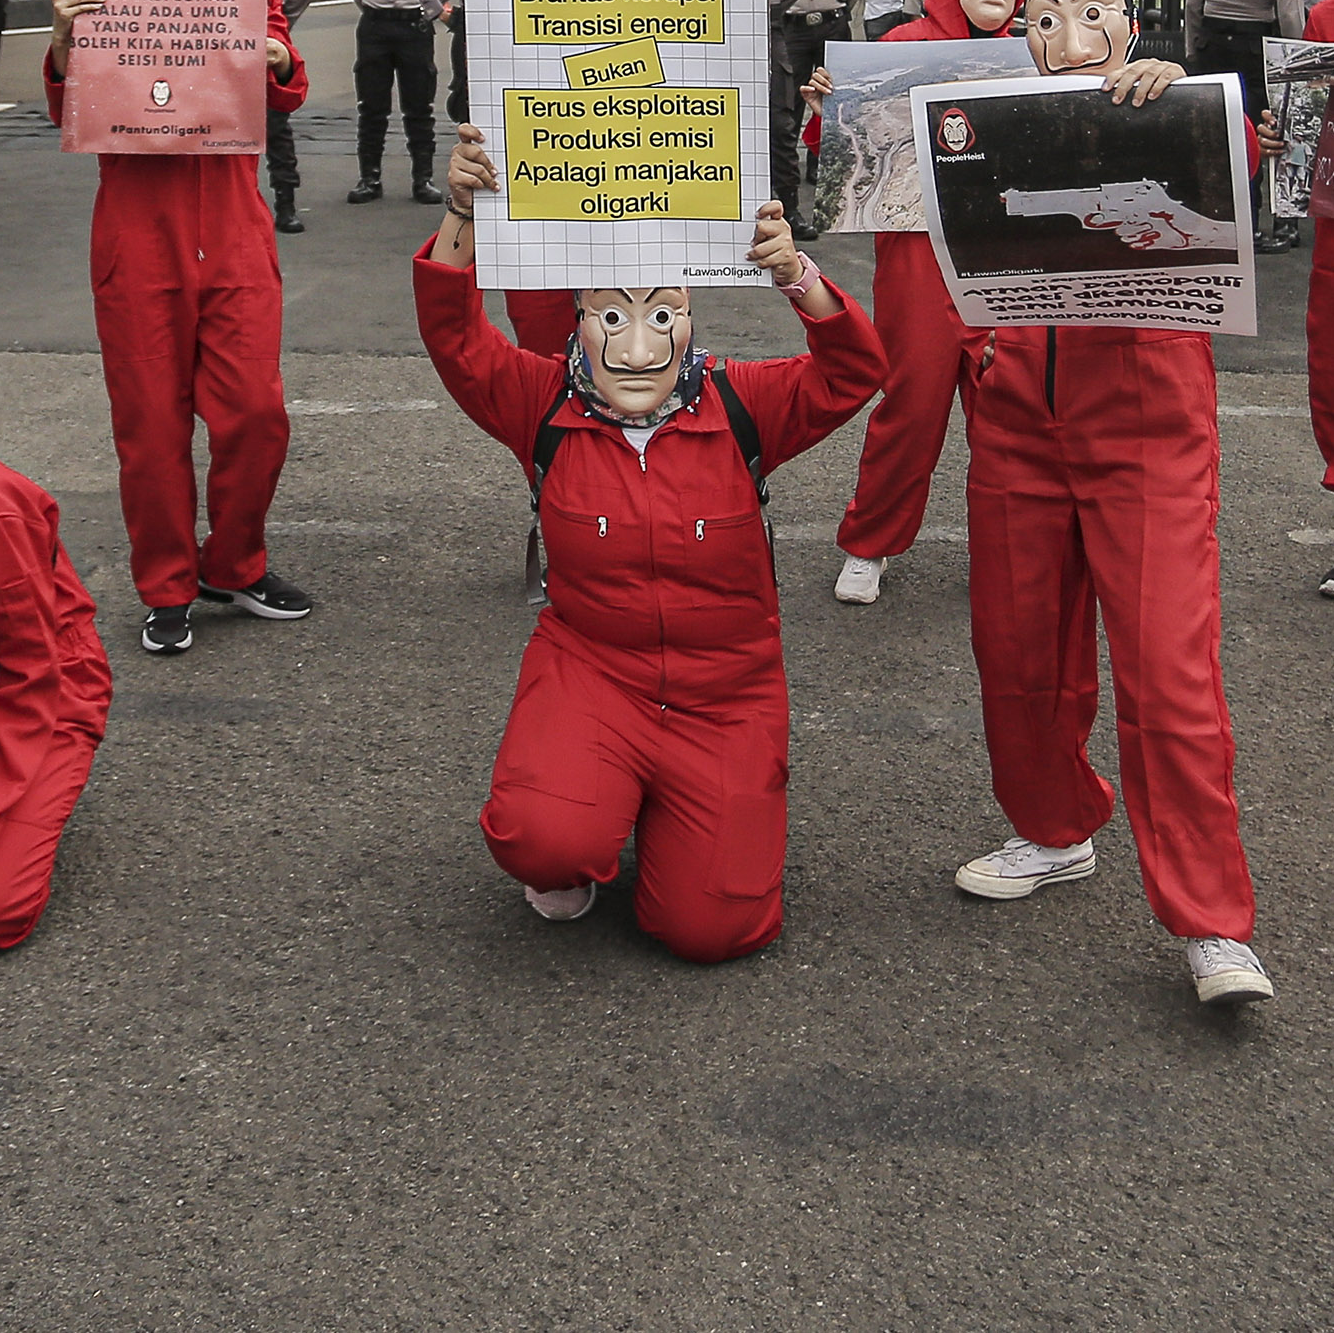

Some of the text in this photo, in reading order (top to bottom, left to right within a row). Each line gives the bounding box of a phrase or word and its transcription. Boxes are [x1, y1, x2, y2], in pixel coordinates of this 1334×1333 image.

[150, 5, 184, 18] ADA
[190, 6, 240, 19] UMUR
[92, 20, 233, 36] YANG PANJANG,
[527, 12, 709, 40] Transisi energi
[127, 38, 164, 50] KITA
[171, 39, 256, 51] HABISKAN
[117, 53, 206, 67] SEISI BUMI
[581, 57, 648, 87] Bukan
[517, 93, 727, 120] Terus eksploitasi
[110, 124, 212, 137] #PantunOligarki
[532, 127, 715, 151] Produksi emisi
[935, 152, 986, 164] PeopleHeist
[514, 160, 734, 187] Apalagi manjakan
[580, 191, 670, 219] oligarki
[682, 266, 763, 279] #LawanOligarki
[960, 268, 1044, 278] #LawanOligarki
[963, 281, 1073, 297] Arman
[985, 288, 1224, 305] mati ditembak
[987, 299, 1225, 314] demi tambang
